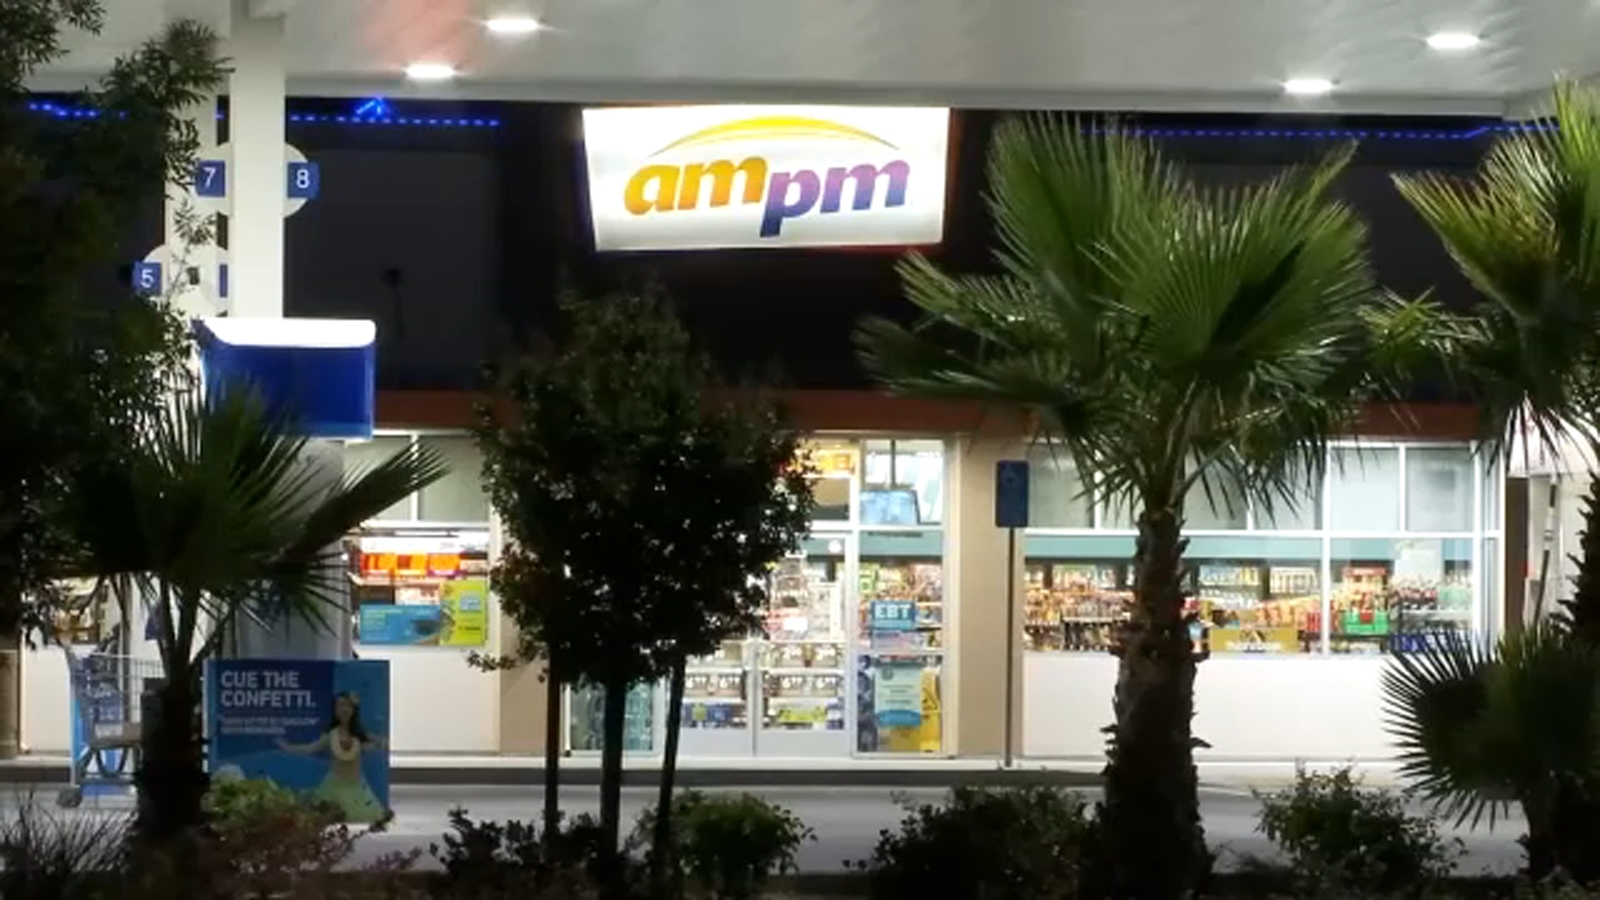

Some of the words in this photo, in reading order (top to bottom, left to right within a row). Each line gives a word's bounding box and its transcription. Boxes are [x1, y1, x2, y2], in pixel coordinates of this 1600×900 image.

[203, 167, 217, 188] 7
[296, 168, 310, 189] 8
[623, 156, 911, 238] ampm
[140, 268, 155, 288] 5
[875, 604, 912, 618] EBT
[220, 670, 258, 688] CUE
[262, 670, 300, 688] THE
[220, 689, 317, 708] CONFETTI.
